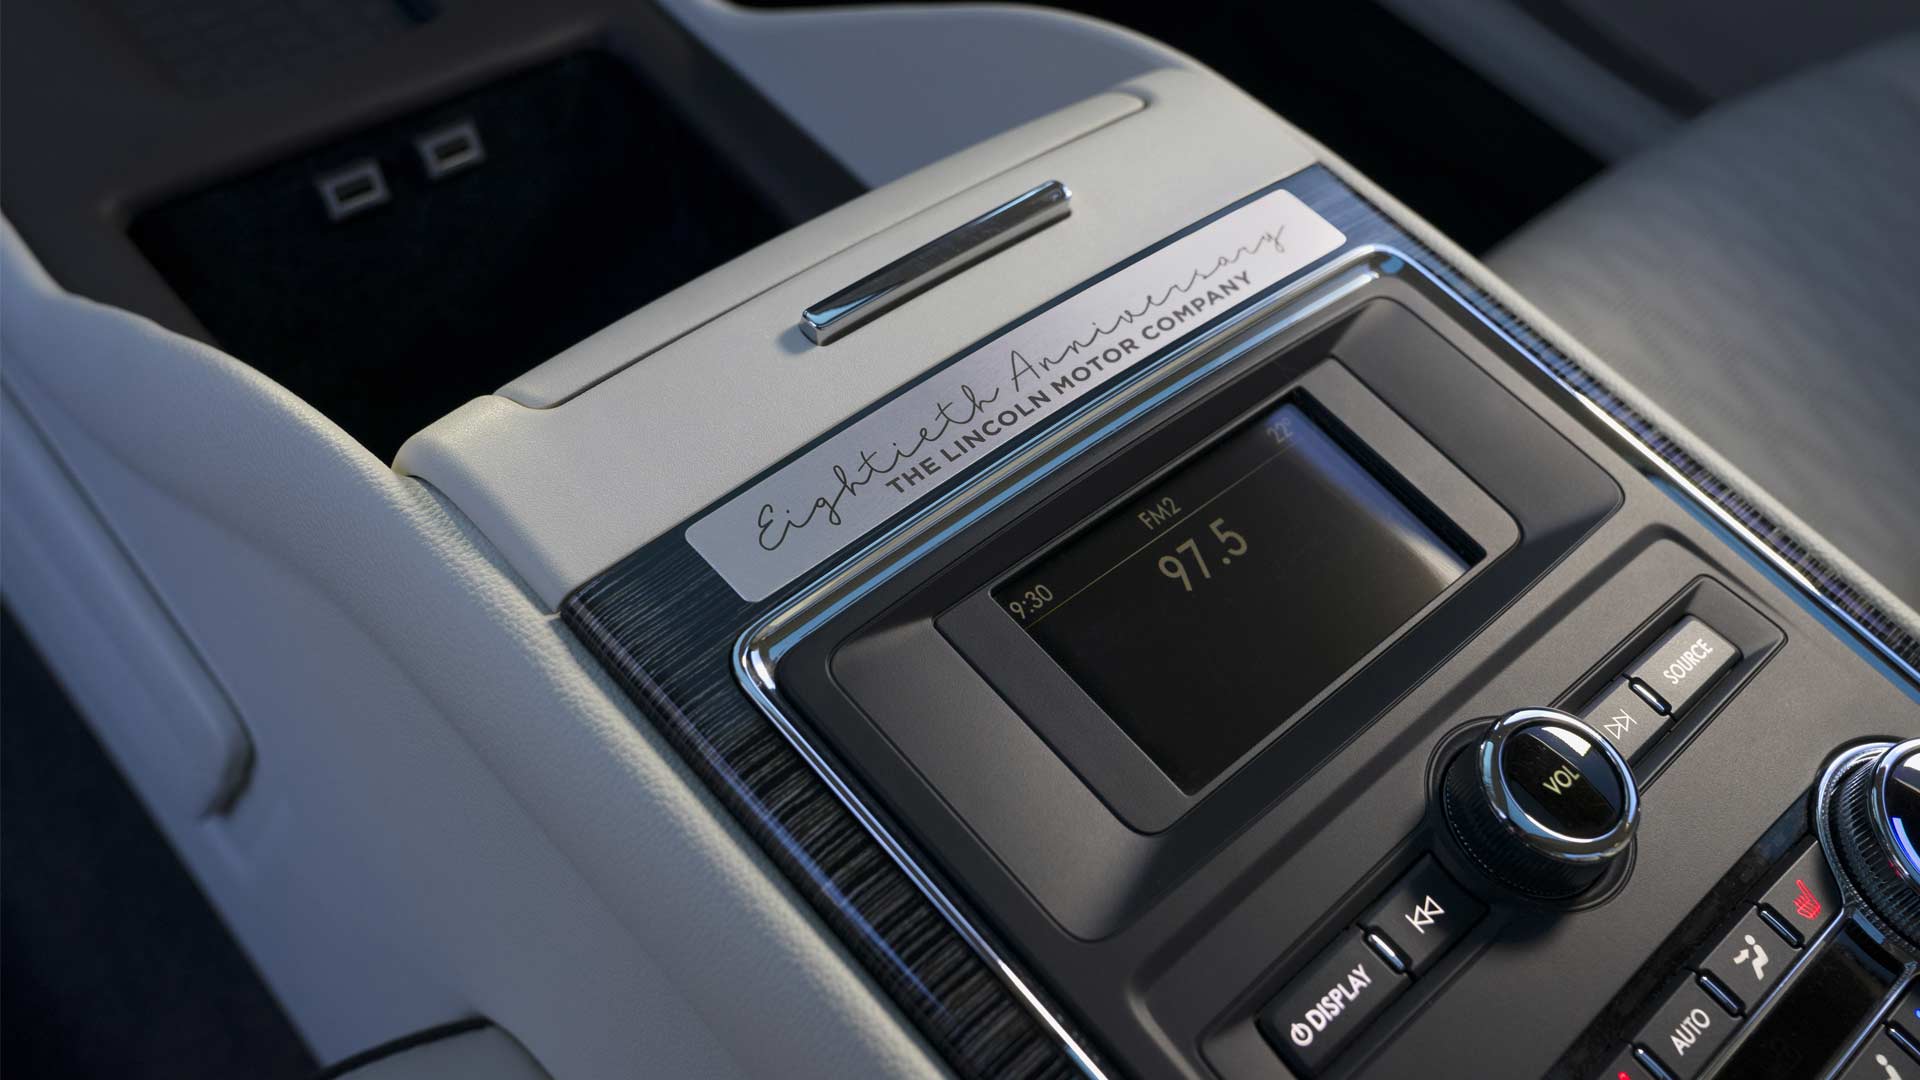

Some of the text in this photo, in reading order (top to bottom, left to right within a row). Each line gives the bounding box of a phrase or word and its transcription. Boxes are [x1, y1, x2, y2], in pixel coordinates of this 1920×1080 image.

[758, 225, 1287, 551] Eightieth Anniversary
[886, 270, 1252, 494] THE LINCOLN MOTOR COMPANY
[1139, 498, 1182, 530] FM2
[1158, 519, 1248, 592] 97.5
[1010, 584, 1053, 620] 9:30
[1663, 638, 1713, 685] SOURCE
[1543, 765, 1580, 795] VOL
[1305, 964, 1371, 1032] DISPLAY
[1670, 1008, 1711, 1056] AUTO
